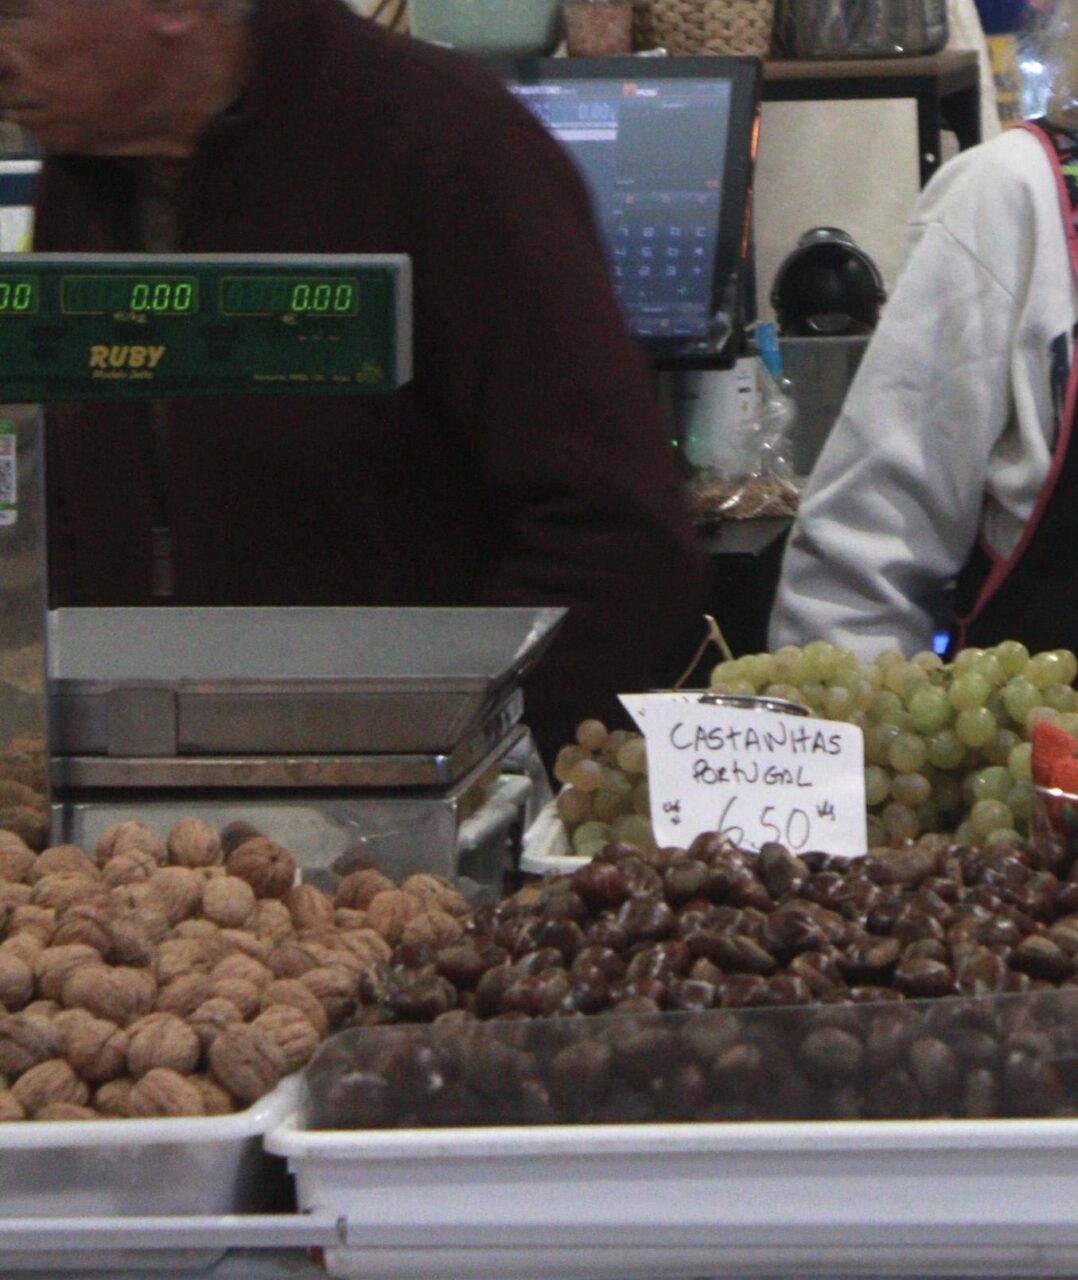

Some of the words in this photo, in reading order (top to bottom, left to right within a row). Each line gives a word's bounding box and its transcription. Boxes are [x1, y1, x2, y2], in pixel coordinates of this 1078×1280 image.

[131, 284, 192, 311] 0.00
[291, 284, 352, 311] 0.00
[89, 345, 166, 368] RUBY
[670, 722, 842, 755] CASTANHAS
